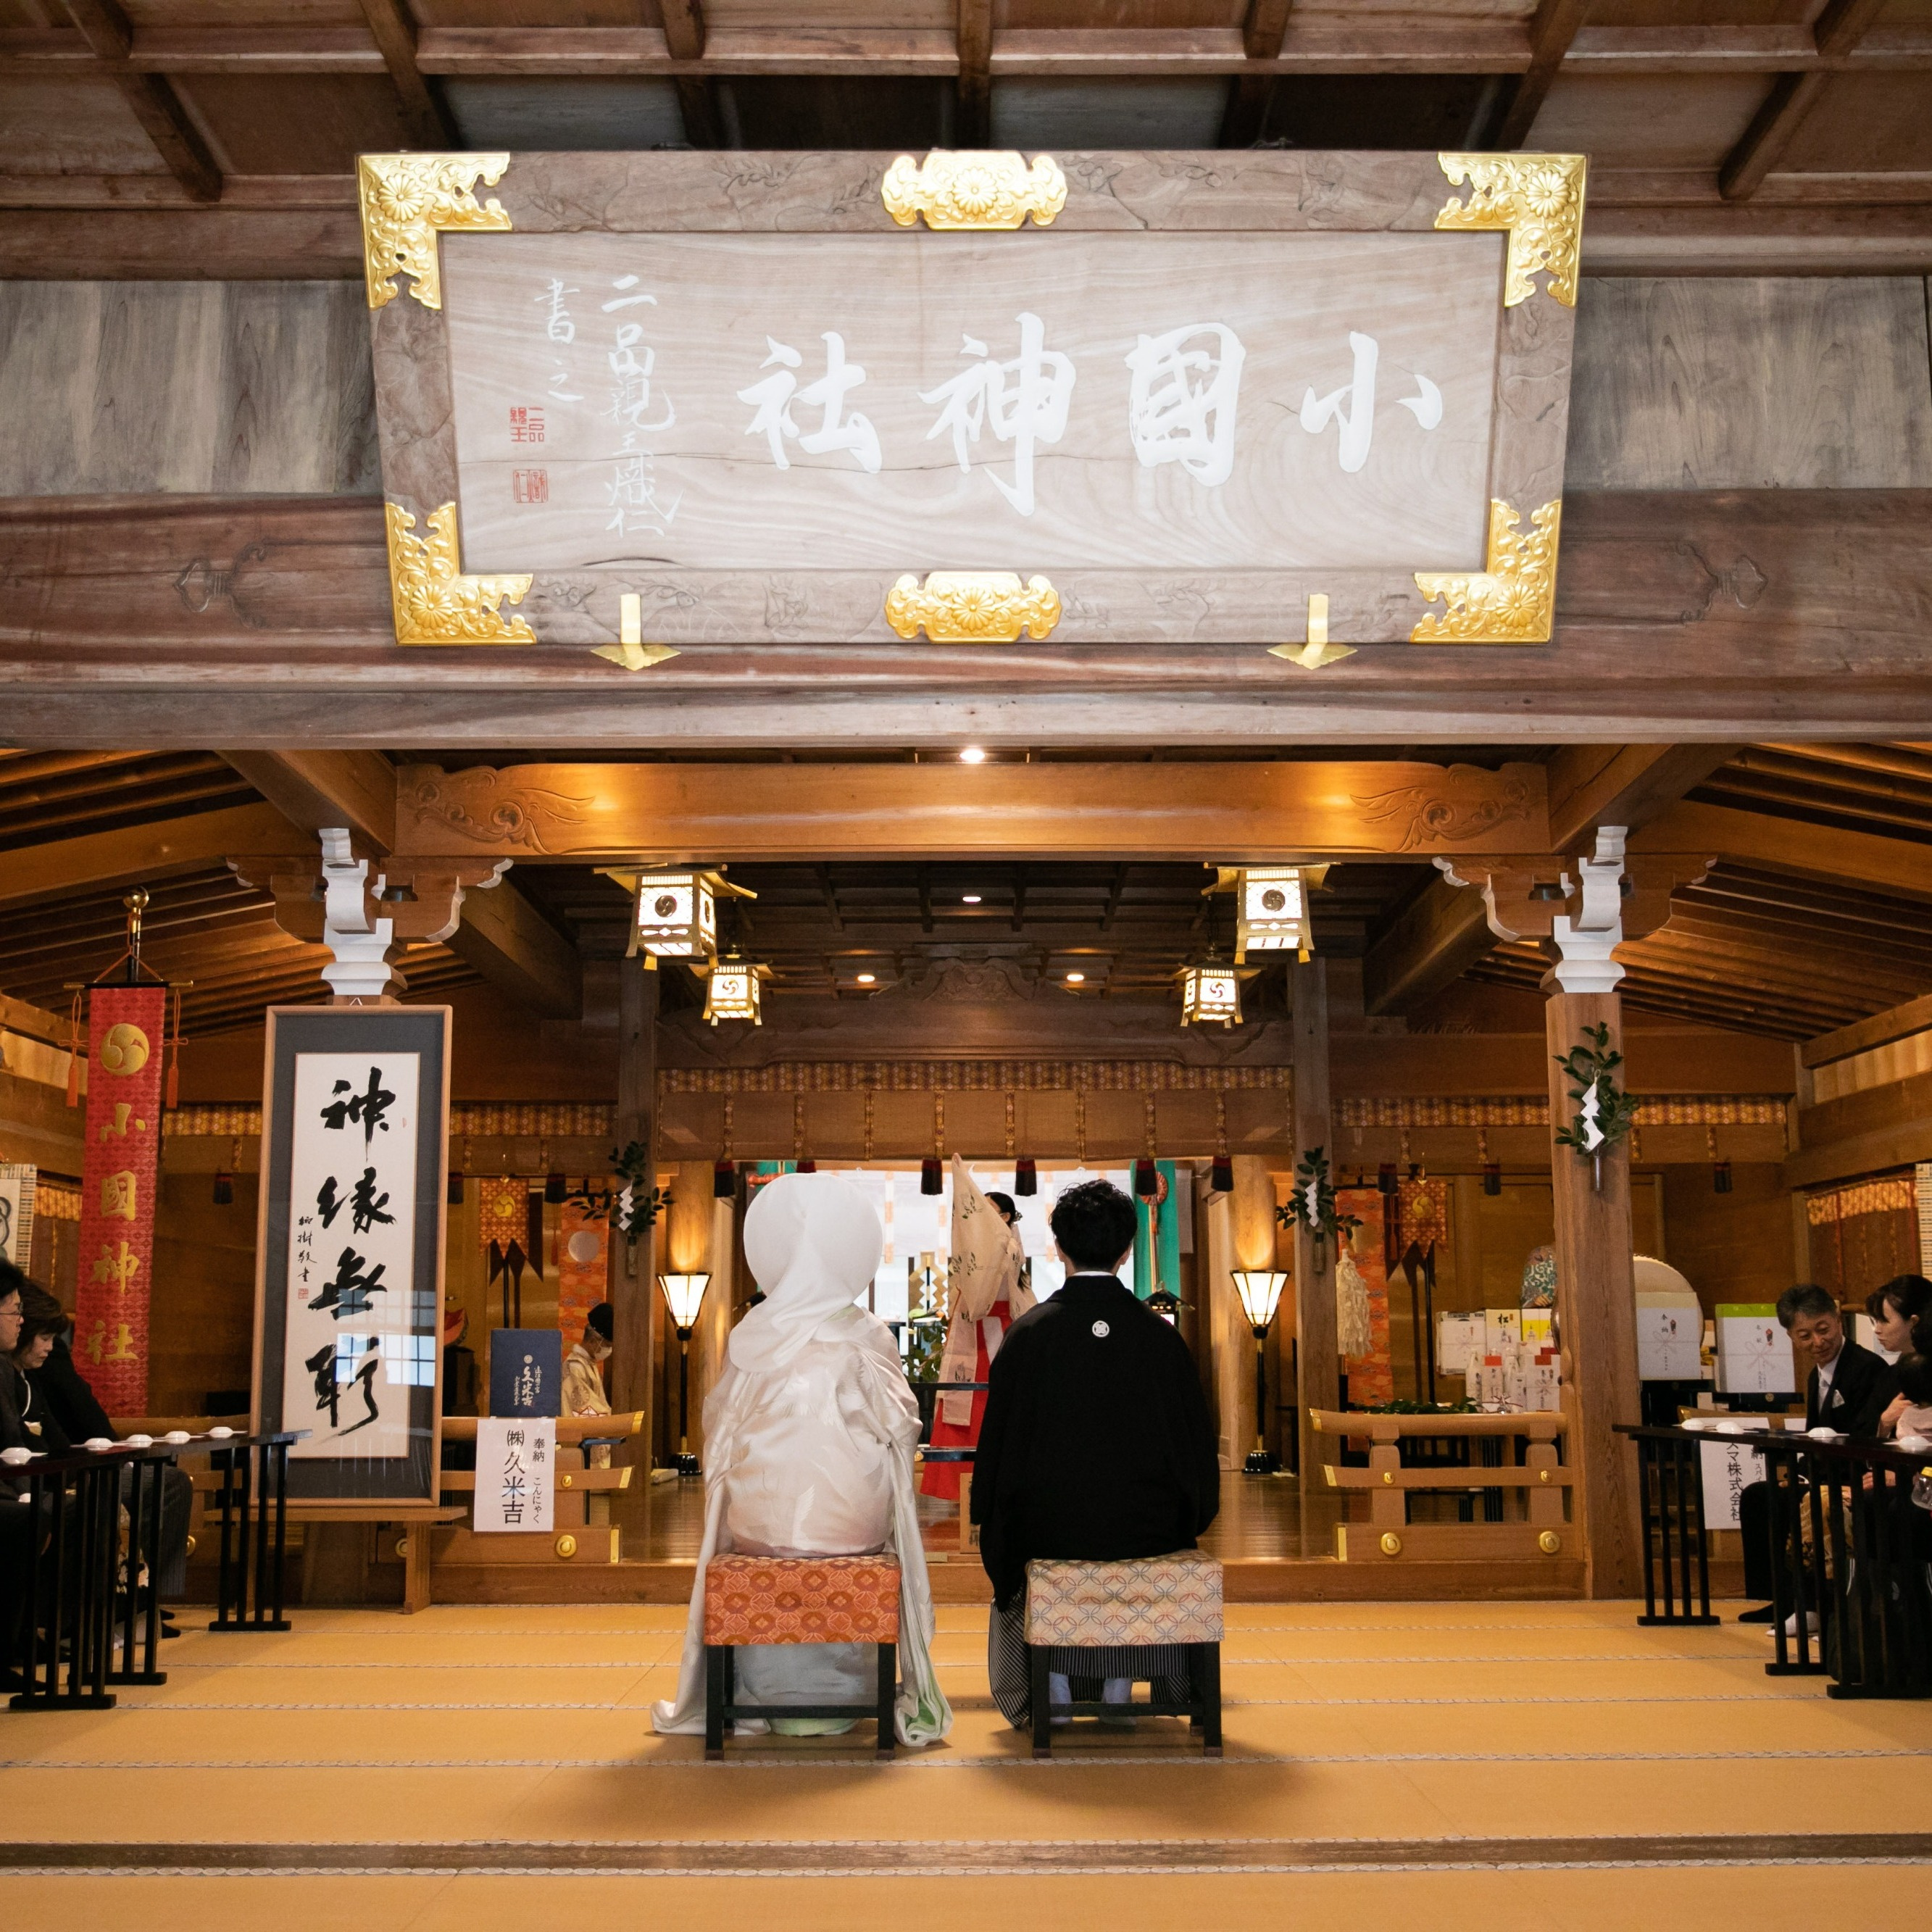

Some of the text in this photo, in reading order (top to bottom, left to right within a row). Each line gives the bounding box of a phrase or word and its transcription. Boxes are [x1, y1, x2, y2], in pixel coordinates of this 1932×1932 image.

[736, 312, 1444, 517] 小國神社
[85, 1102, 146, 1367] 小國神社
[521, 1366, 535, 1406] 久米吉
[532, 1437, 546, 1524] 奉納 こんにゃく
